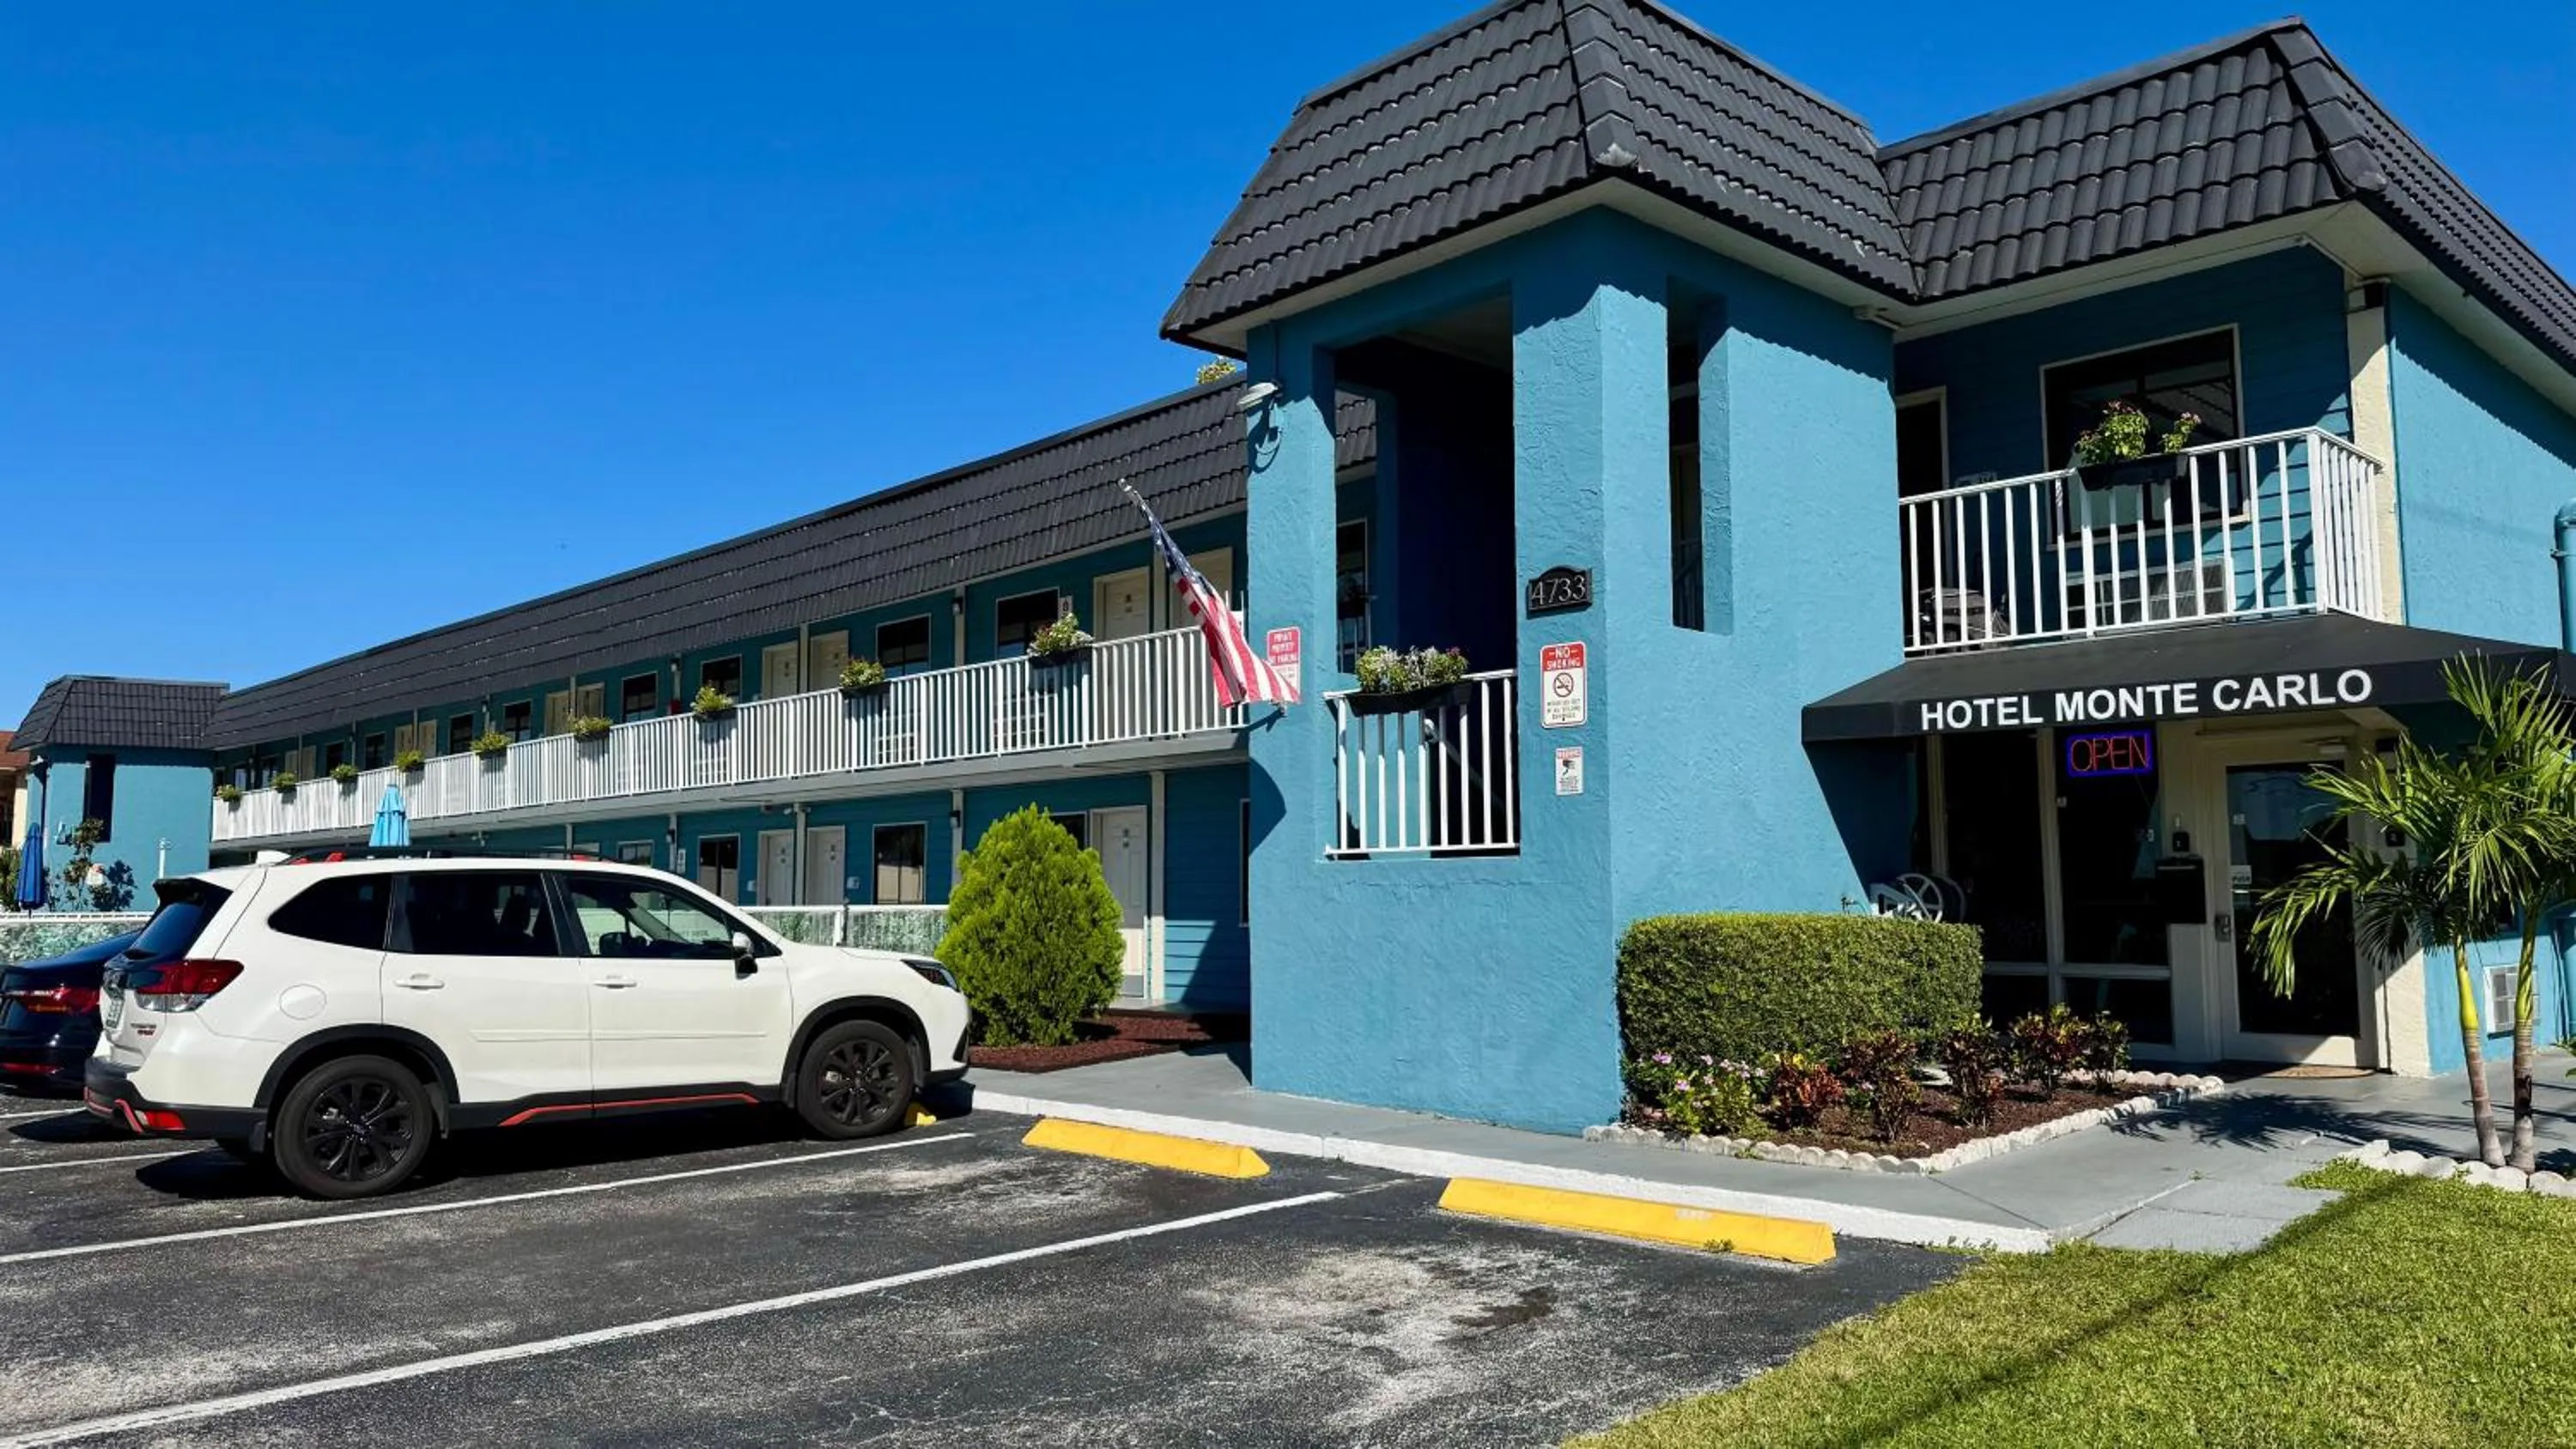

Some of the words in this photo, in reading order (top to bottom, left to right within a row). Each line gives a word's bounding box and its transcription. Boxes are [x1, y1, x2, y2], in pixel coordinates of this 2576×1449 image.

[1532, 575, 1585, 604] 4733
[1546, 658, 1581, 670] SMOKING
[1555, 646, 1571, 659] NO
[1922, 695, 2044, 731] HOTEL
[2055, 682, 2198, 722] MONTE
[2212, 670, 2372, 712] CARLO
[2070, 733, 2150, 772] OPEN
